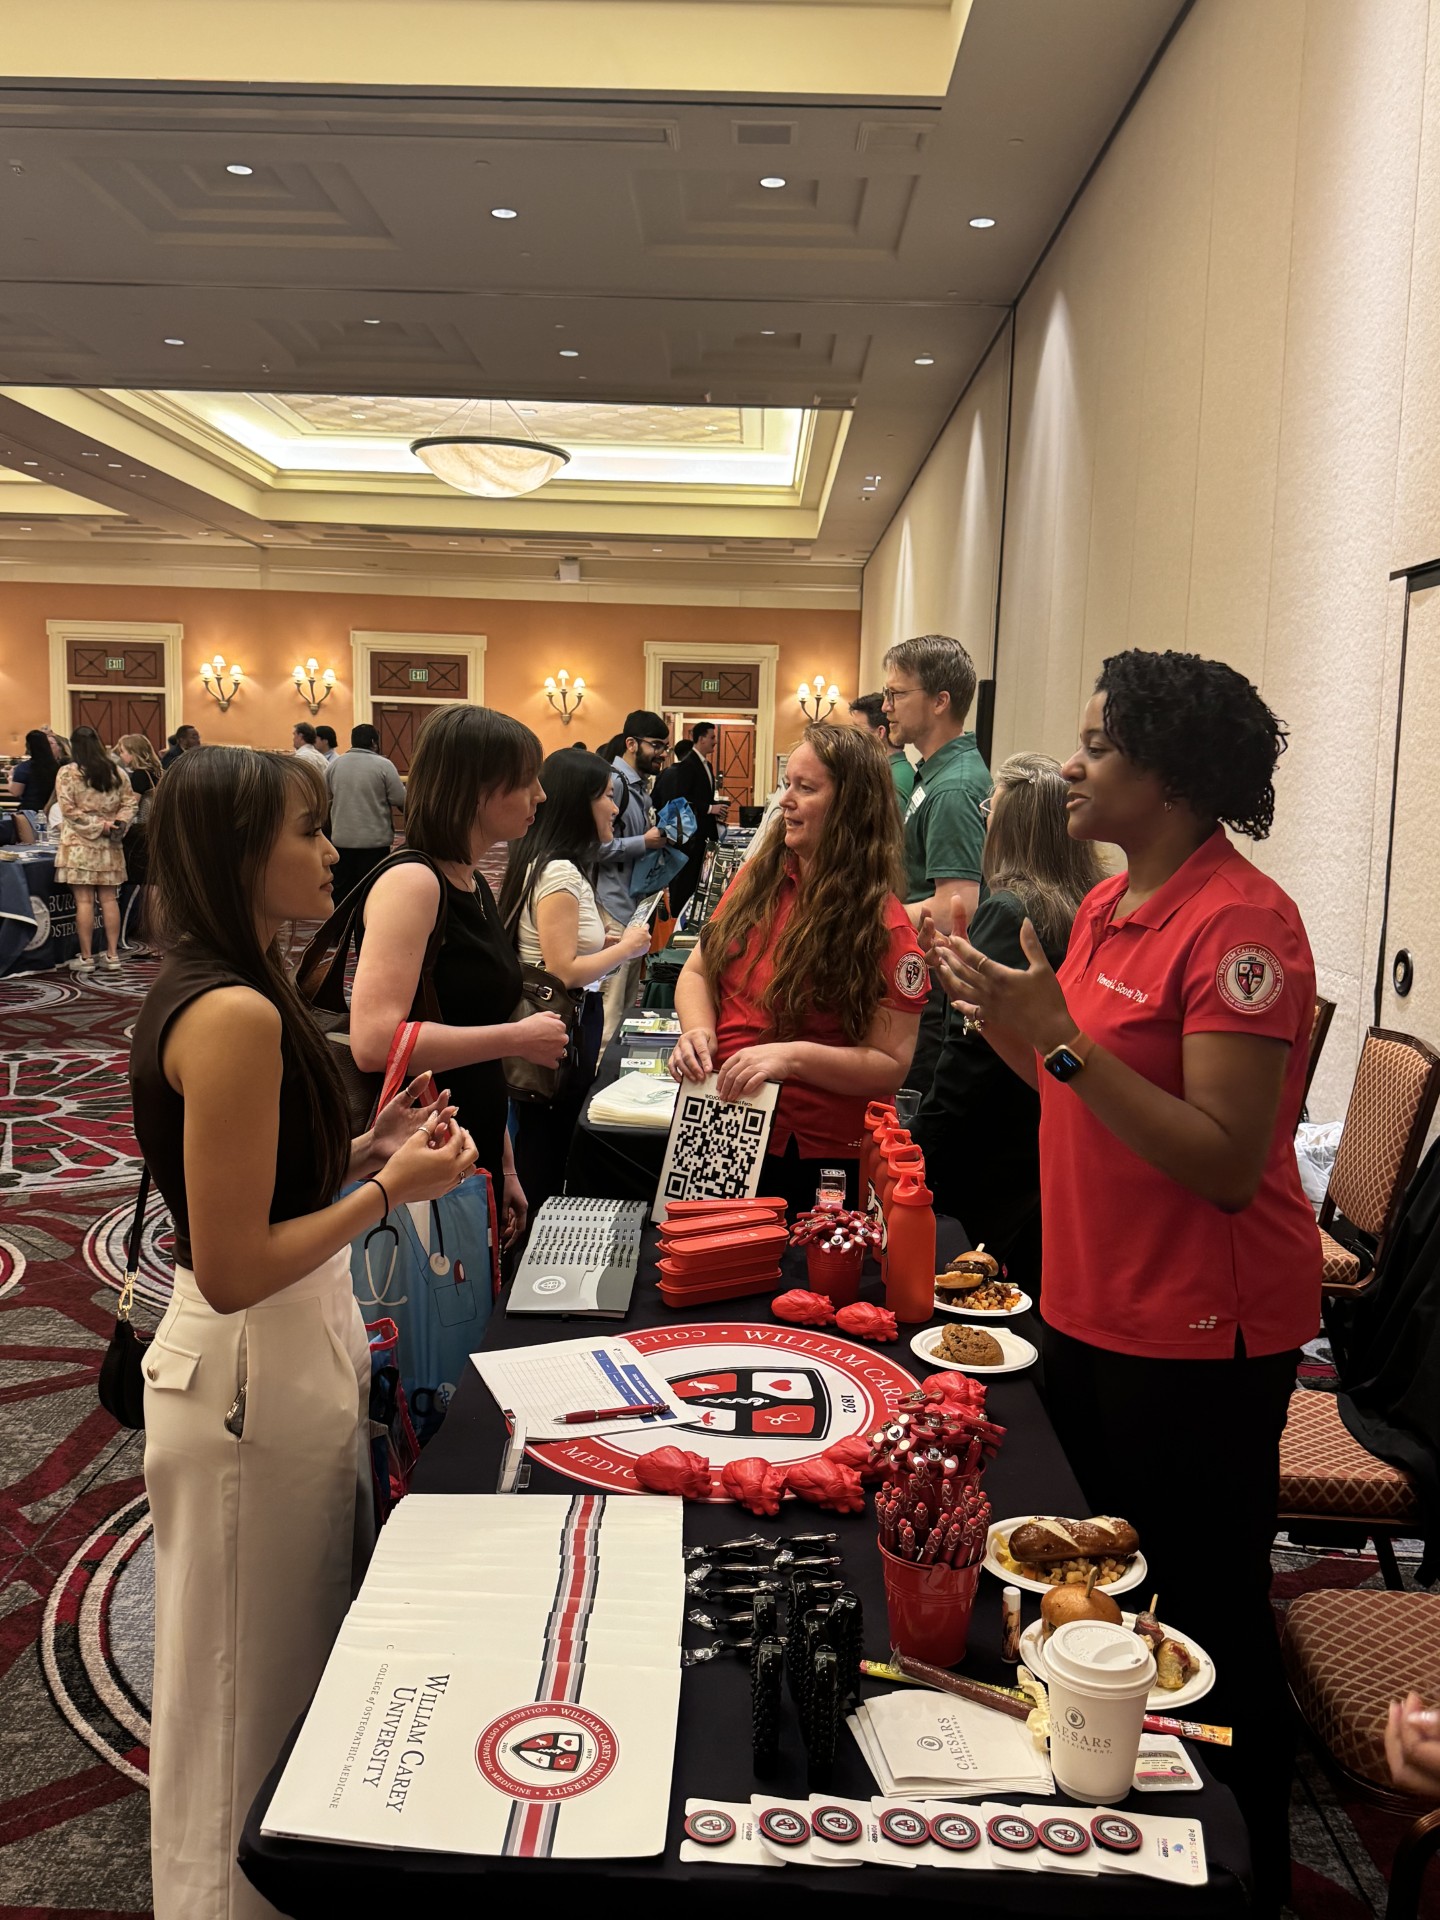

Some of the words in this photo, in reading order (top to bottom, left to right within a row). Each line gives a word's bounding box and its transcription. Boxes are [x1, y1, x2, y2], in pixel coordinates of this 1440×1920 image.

[108, 659, 122, 669] EXIT
[412, 670, 426, 680] EXIT
[704, 680, 718, 690] EXIT
[630, 1330, 706, 1347] COLLE
[743, 1330, 869, 1368] WILLIAM
[841, 1394, 856, 1414] 1892
[374, 1663, 389, 1695] COLLEGE
[367, 1696, 376, 1707] of
[406, 1673, 450, 1744] WILLIAM
[510, 1707, 548, 1722] COLLEGE
[349, 1706, 373, 1762] OSTEOPATHIC
[499, 1721, 509, 1730] OF
[560, 1708, 603, 1733] WILLIAM
[362, 1687, 418, 1788] UNIVERSITY
[482, 1729, 500, 1772] OSTEOPATHIC
[598, 1733, 612, 1761] CAREY
[937, 1717, 970, 1770] CAESARS
[329, 1764, 352, 1809] MEDICINE
[385, 1750, 425, 1813] CAREY
[491, 1772, 532, 1796] MEDICINE
[545, 1762, 608, 1797] UNIVERSITY
